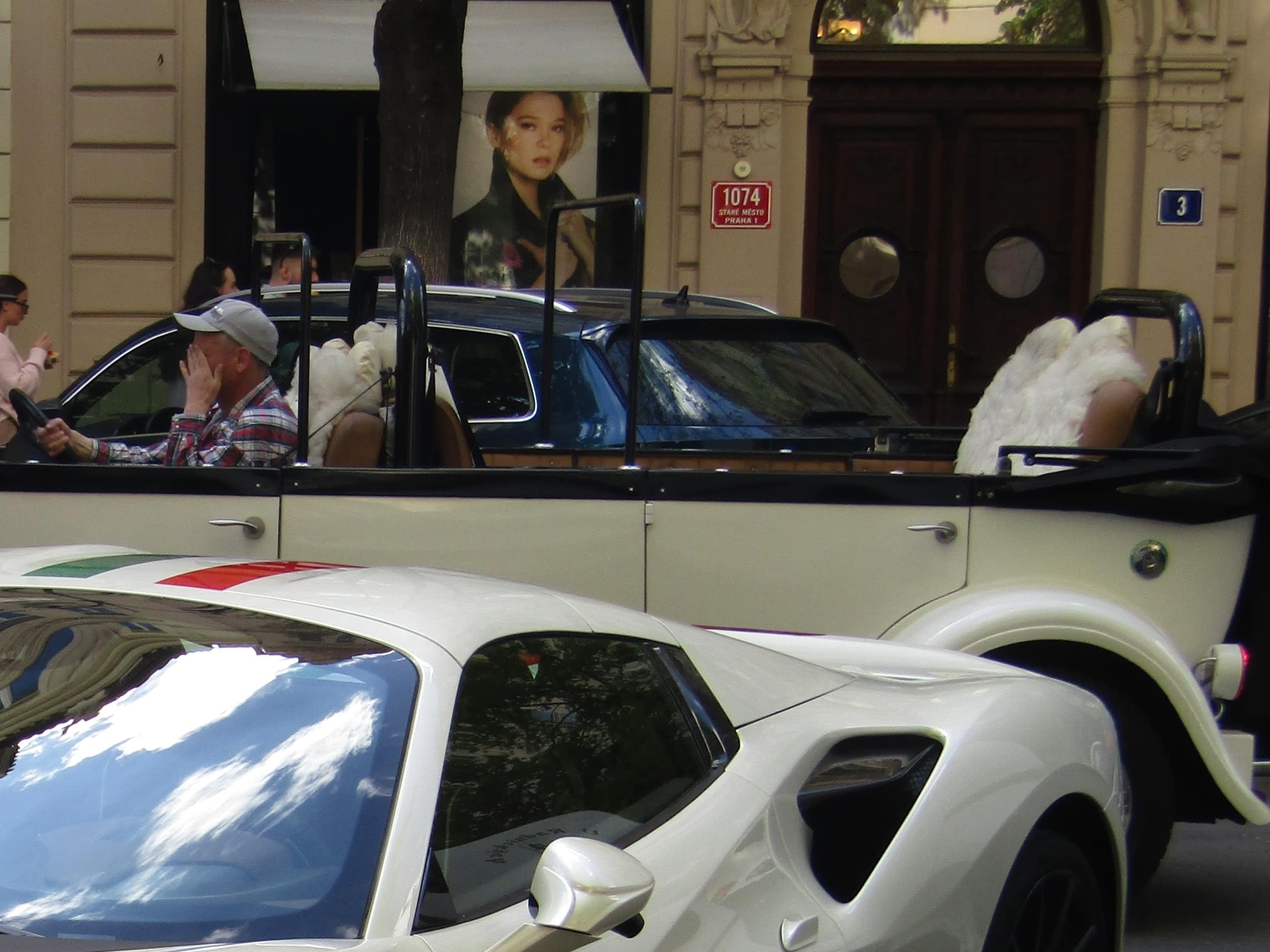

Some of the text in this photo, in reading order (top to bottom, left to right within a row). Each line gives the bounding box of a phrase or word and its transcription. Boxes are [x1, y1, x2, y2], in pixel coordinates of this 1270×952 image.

[723, 187, 760, 206] 1074
[719, 208, 739, 216] STARÉ
[1176, 196, 1187, 217] 3
